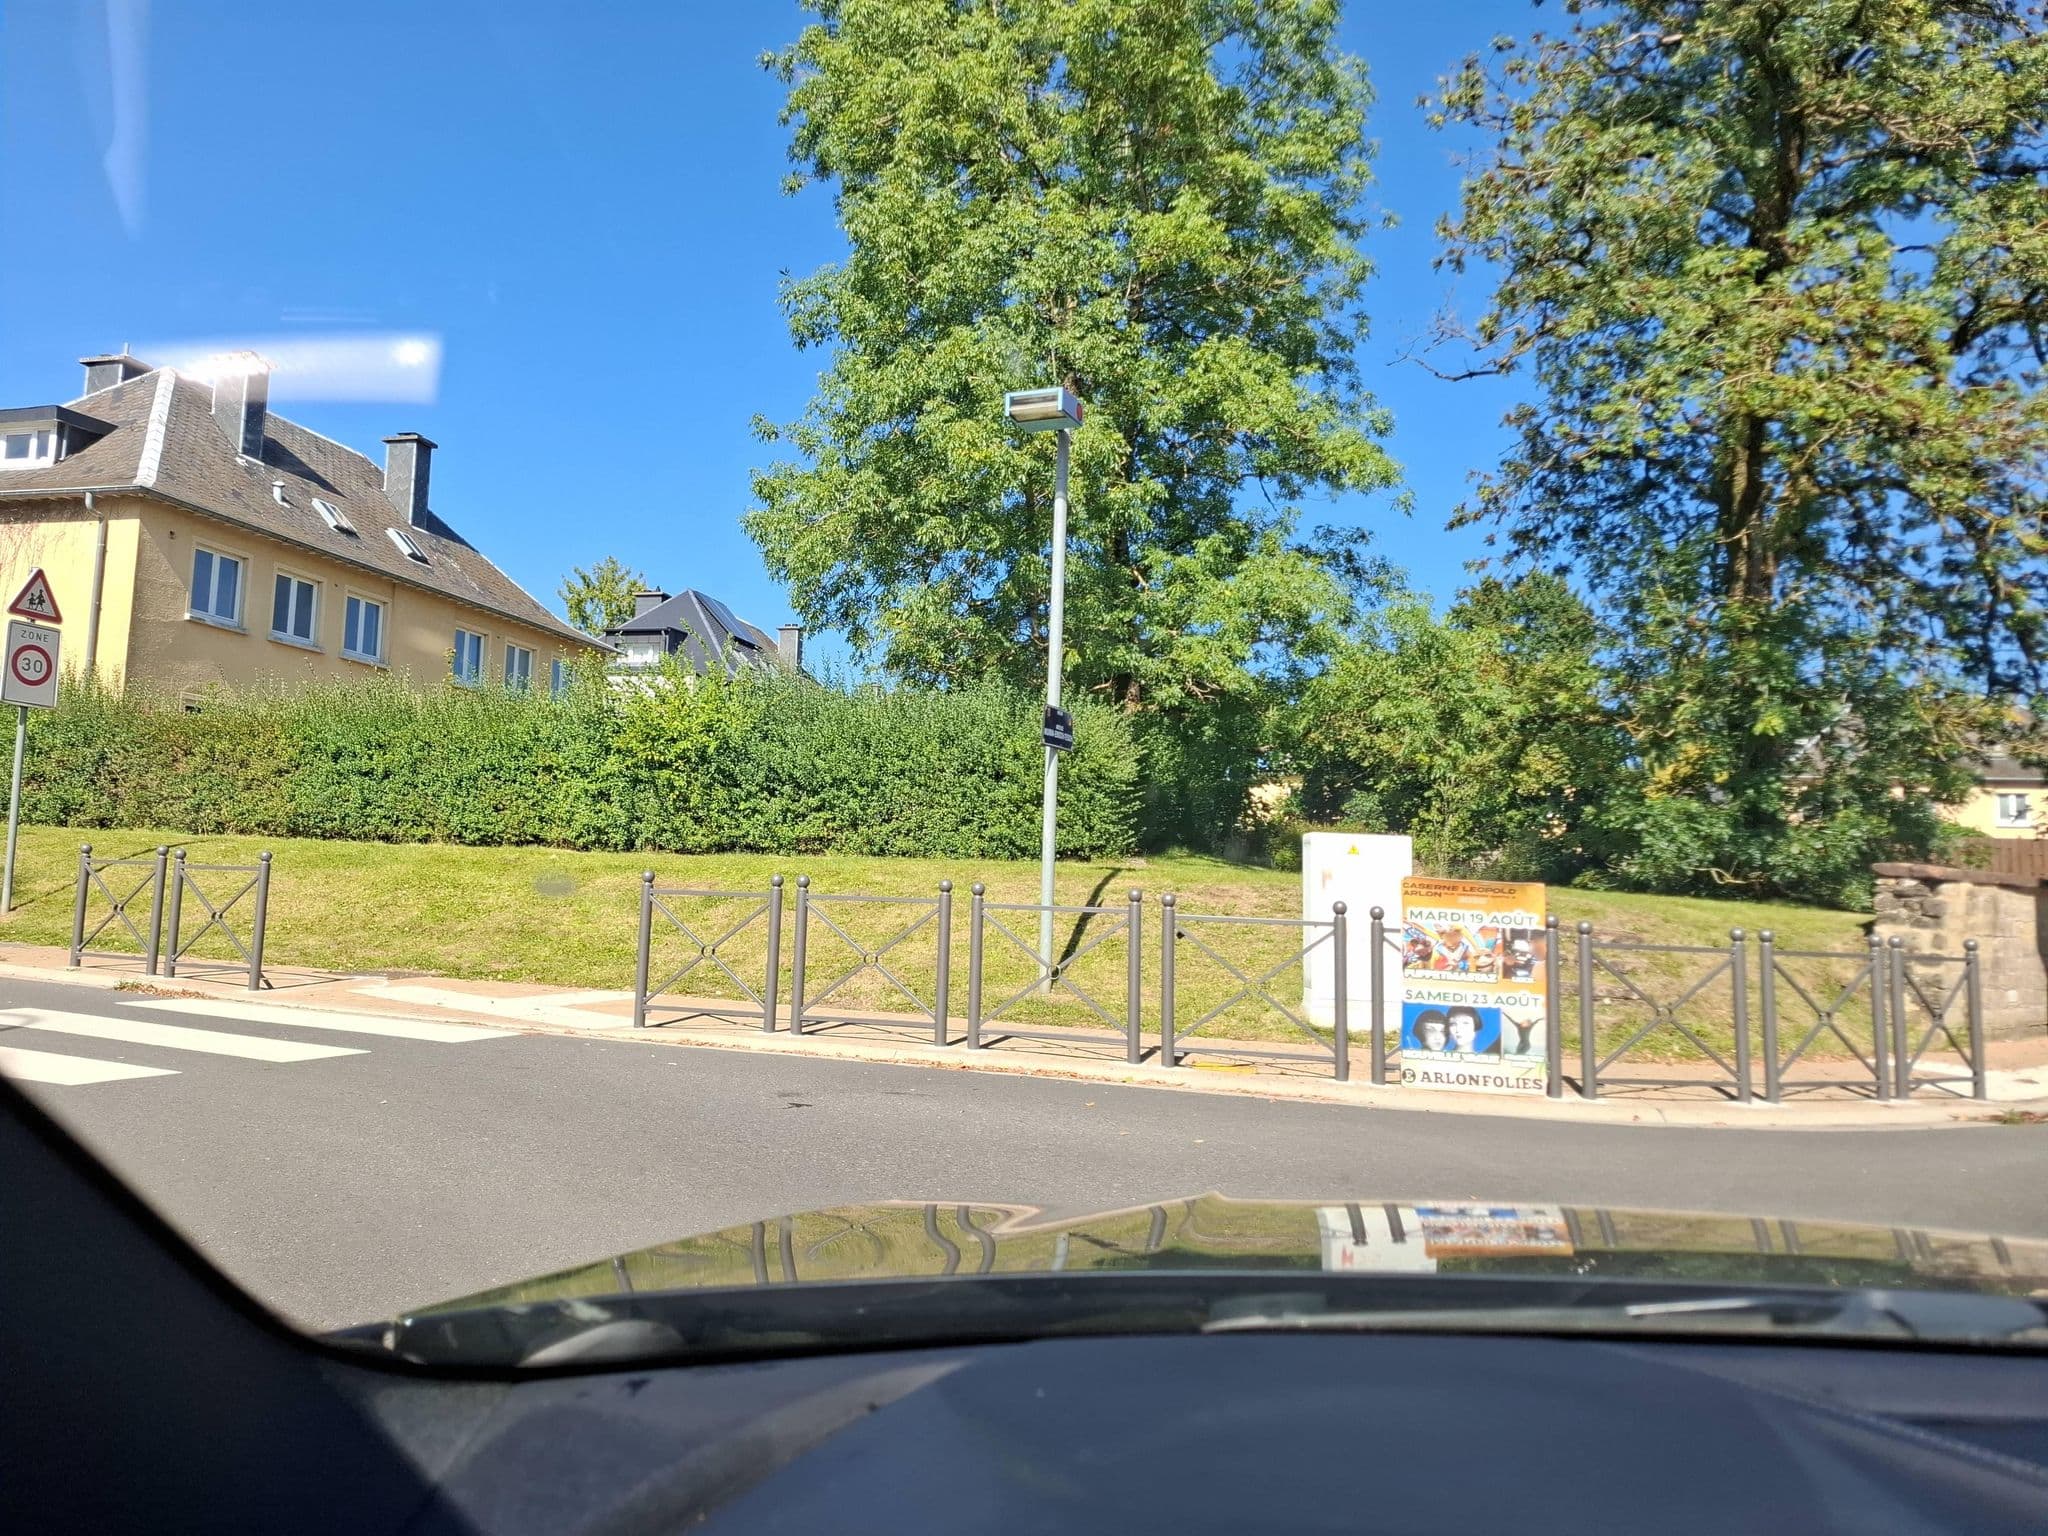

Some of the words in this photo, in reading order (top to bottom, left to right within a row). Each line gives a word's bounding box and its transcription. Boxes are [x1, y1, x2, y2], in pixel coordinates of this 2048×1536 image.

[20, 629, 49, 643] ZONE
[21, 657, 43, 674] 30
[1402, 881, 1459, 892] CASERNE
[1461, 885, 1517, 895] LEOPOLD
[1403, 889, 1442, 898] ARLON
[1409, 909, 1465, 922] MARDI
[1471, 913, 1484, 924] 19
[1489, 912, 1535, 926] AOÛT
[1405, 988, 1468, 1004] SAMEDI
[1472, 993, 1488, 1005] 23
[1493, 992, 1541, 1008] AOÛT
[1420, 1071, 1544, 1090] ARLONFOLIES
